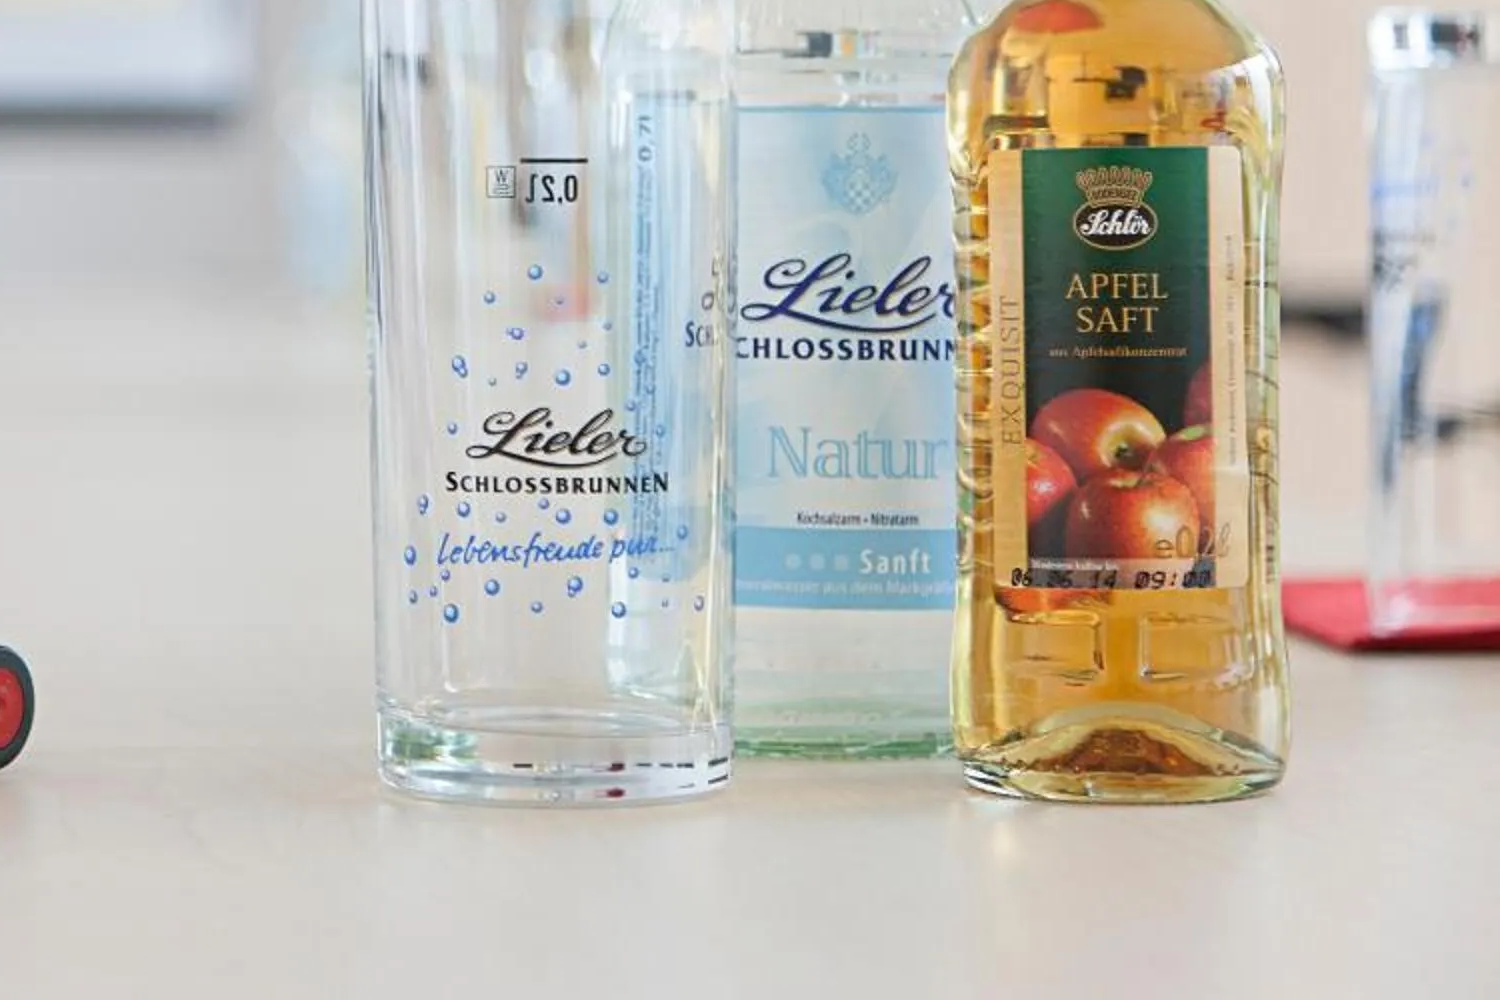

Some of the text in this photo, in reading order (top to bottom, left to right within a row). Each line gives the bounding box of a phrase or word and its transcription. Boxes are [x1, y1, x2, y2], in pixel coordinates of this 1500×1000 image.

[1080, 208, 1152, 237] Schlör
[1065, 272, 1169, 300] APFEL
[1076, 306, 1160, 334] SAFT
[1000, 296, 1024, 444] EXQUISIT
[465, 407, 648, 468] Lieler
[766, 425, 948, 481] Natur
[445, 471, 669, 494] SCHLOSSBRUNNEN
[797, 511, 861, 526] Kochsalzarm
[437, 532, 604, 569] Lebensfreude
[859, 548, 931, 575] Sanft
